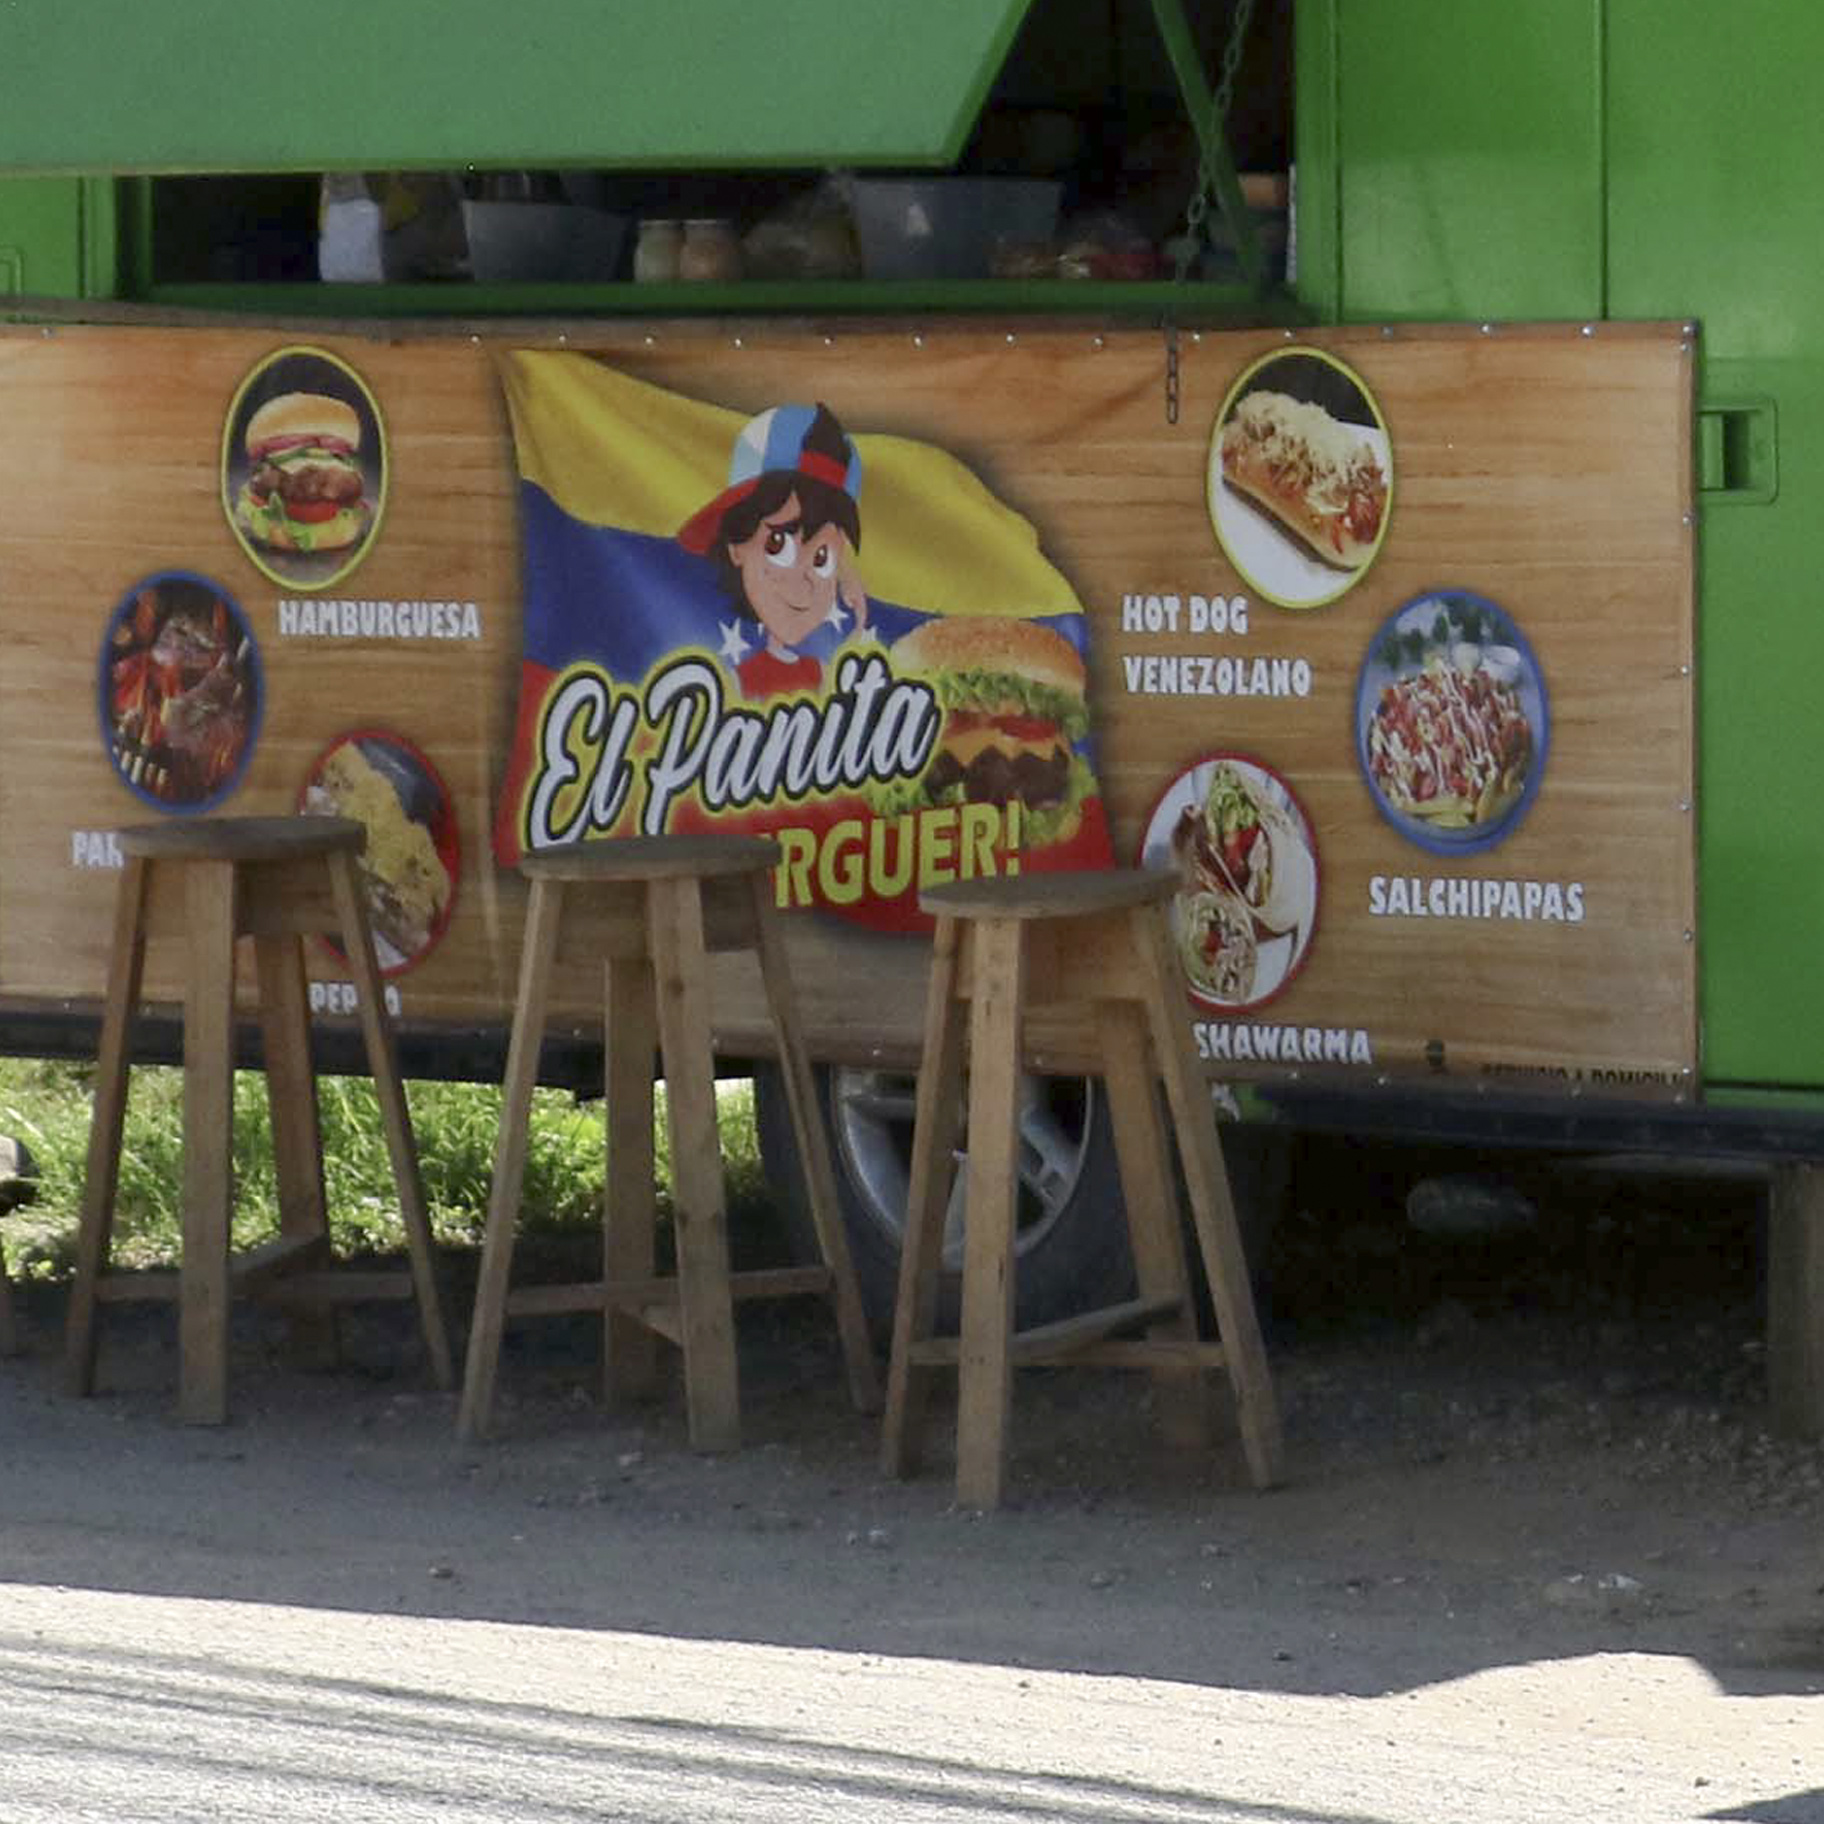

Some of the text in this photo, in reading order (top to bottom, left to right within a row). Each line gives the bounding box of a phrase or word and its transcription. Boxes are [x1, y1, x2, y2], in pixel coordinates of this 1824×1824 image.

[279, 600, 480, 638] HAMBURGUESA
[1122, 595, 1249, 635] HOT DOG
[1124, 657, 1311, 697] VENEZOLANO
[529, 652, 939, 849] El Panita
[775, 799, 1020, 908] RGUER!
[1369, 876, 1584, 922] SALCHIPAPAS
[309, 982, 401, 1016] PEPO
[1193, 1023, 1371, 1060] SHAWARMA
